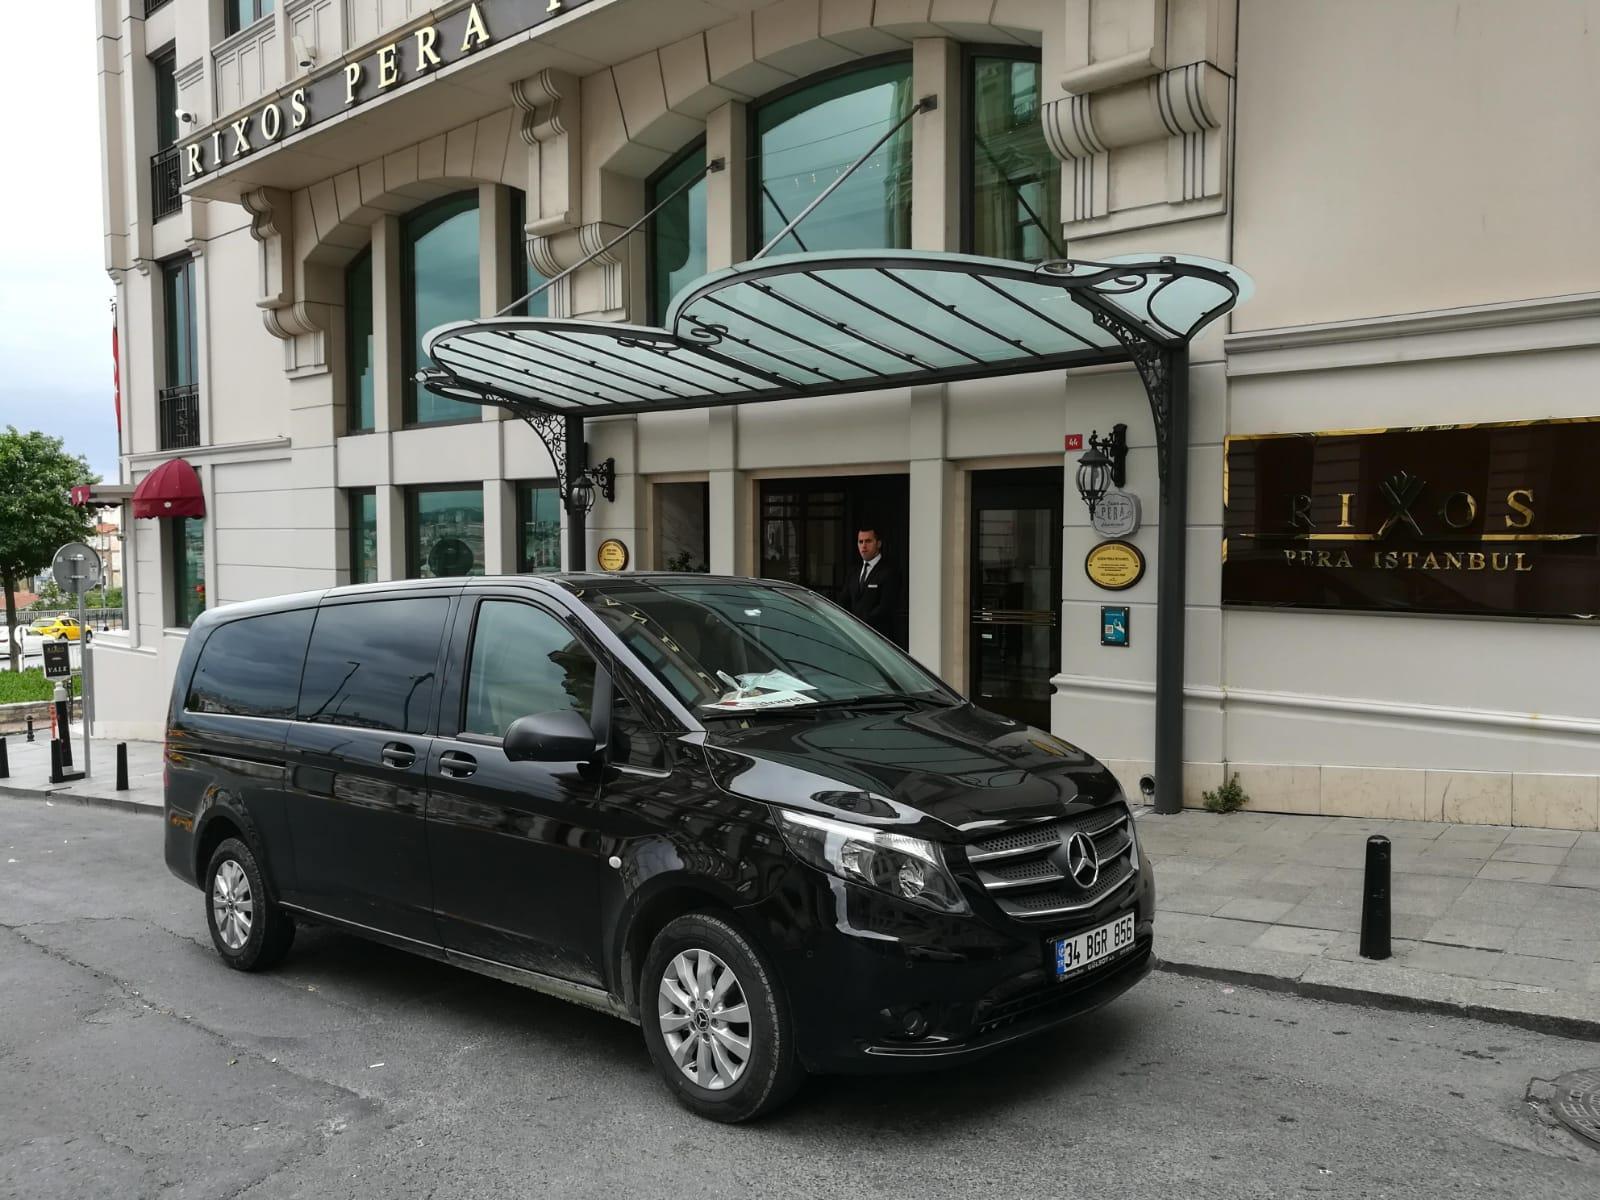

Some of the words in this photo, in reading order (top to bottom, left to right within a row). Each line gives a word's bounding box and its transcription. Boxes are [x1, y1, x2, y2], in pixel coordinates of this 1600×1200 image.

[187, 88, 307, 178] RIXOS
[344, 3, 490, 105] PERA
[1069, 437, 1078, 446] 44
[1101, 506, 1125, 521] PERA
[1288, 471, 1535, 536] RIXOS
[1284, 550, 1353, 569] PERA
[1373, 550, 1533, 572] ISTANBUL
[1065, 940, 1080, 968] 34
[1087, 928, 1107, 960] BGR
[1114, 917, 1132, 946] 856
